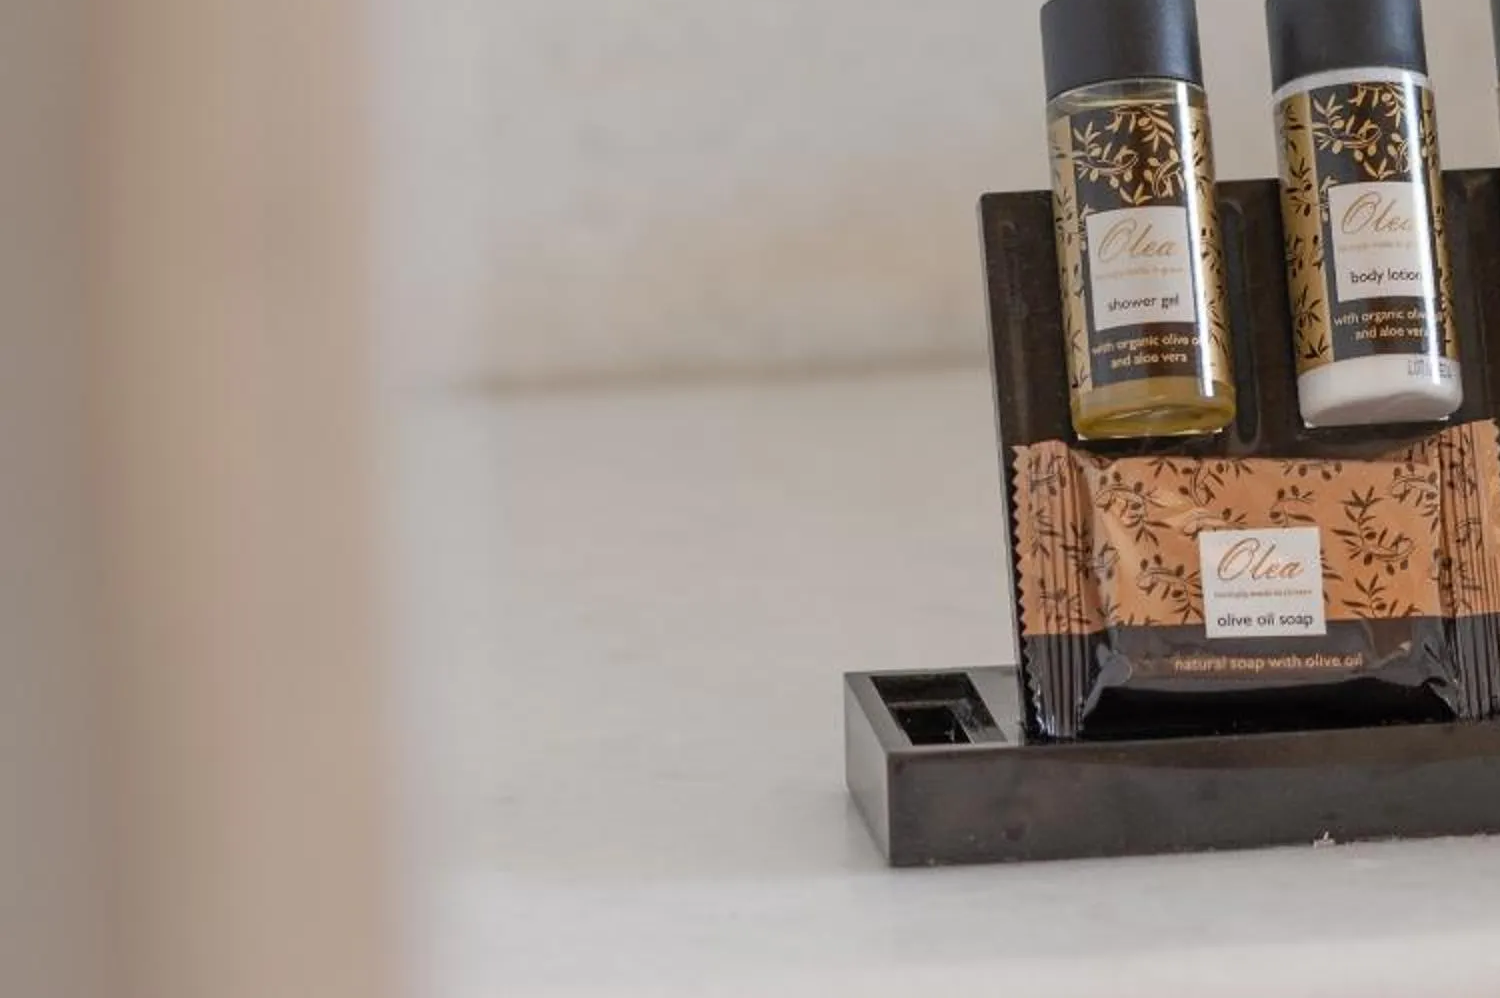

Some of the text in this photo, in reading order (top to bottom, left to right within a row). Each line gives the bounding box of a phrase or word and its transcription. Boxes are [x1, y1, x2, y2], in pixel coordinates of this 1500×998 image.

[1097, 218, 1177, 263] Olea
[1350, 270, 1384, 287] body
[1108, 292, 1180, 312] shower gel
[1333, 313, 1359, 326] with
[1355, 326, 1377, 340] and
[1380, 325, 1405, 338] aloe
[1111, 353, 1131, 369] and
[1161, 352, 1188, 363] vera
[1216, 537, 1304, 581] Olea
[1217, 612, 1313, 629] olive oil soap
[1174, 653, 1363, 673] natural soap with olive oil
